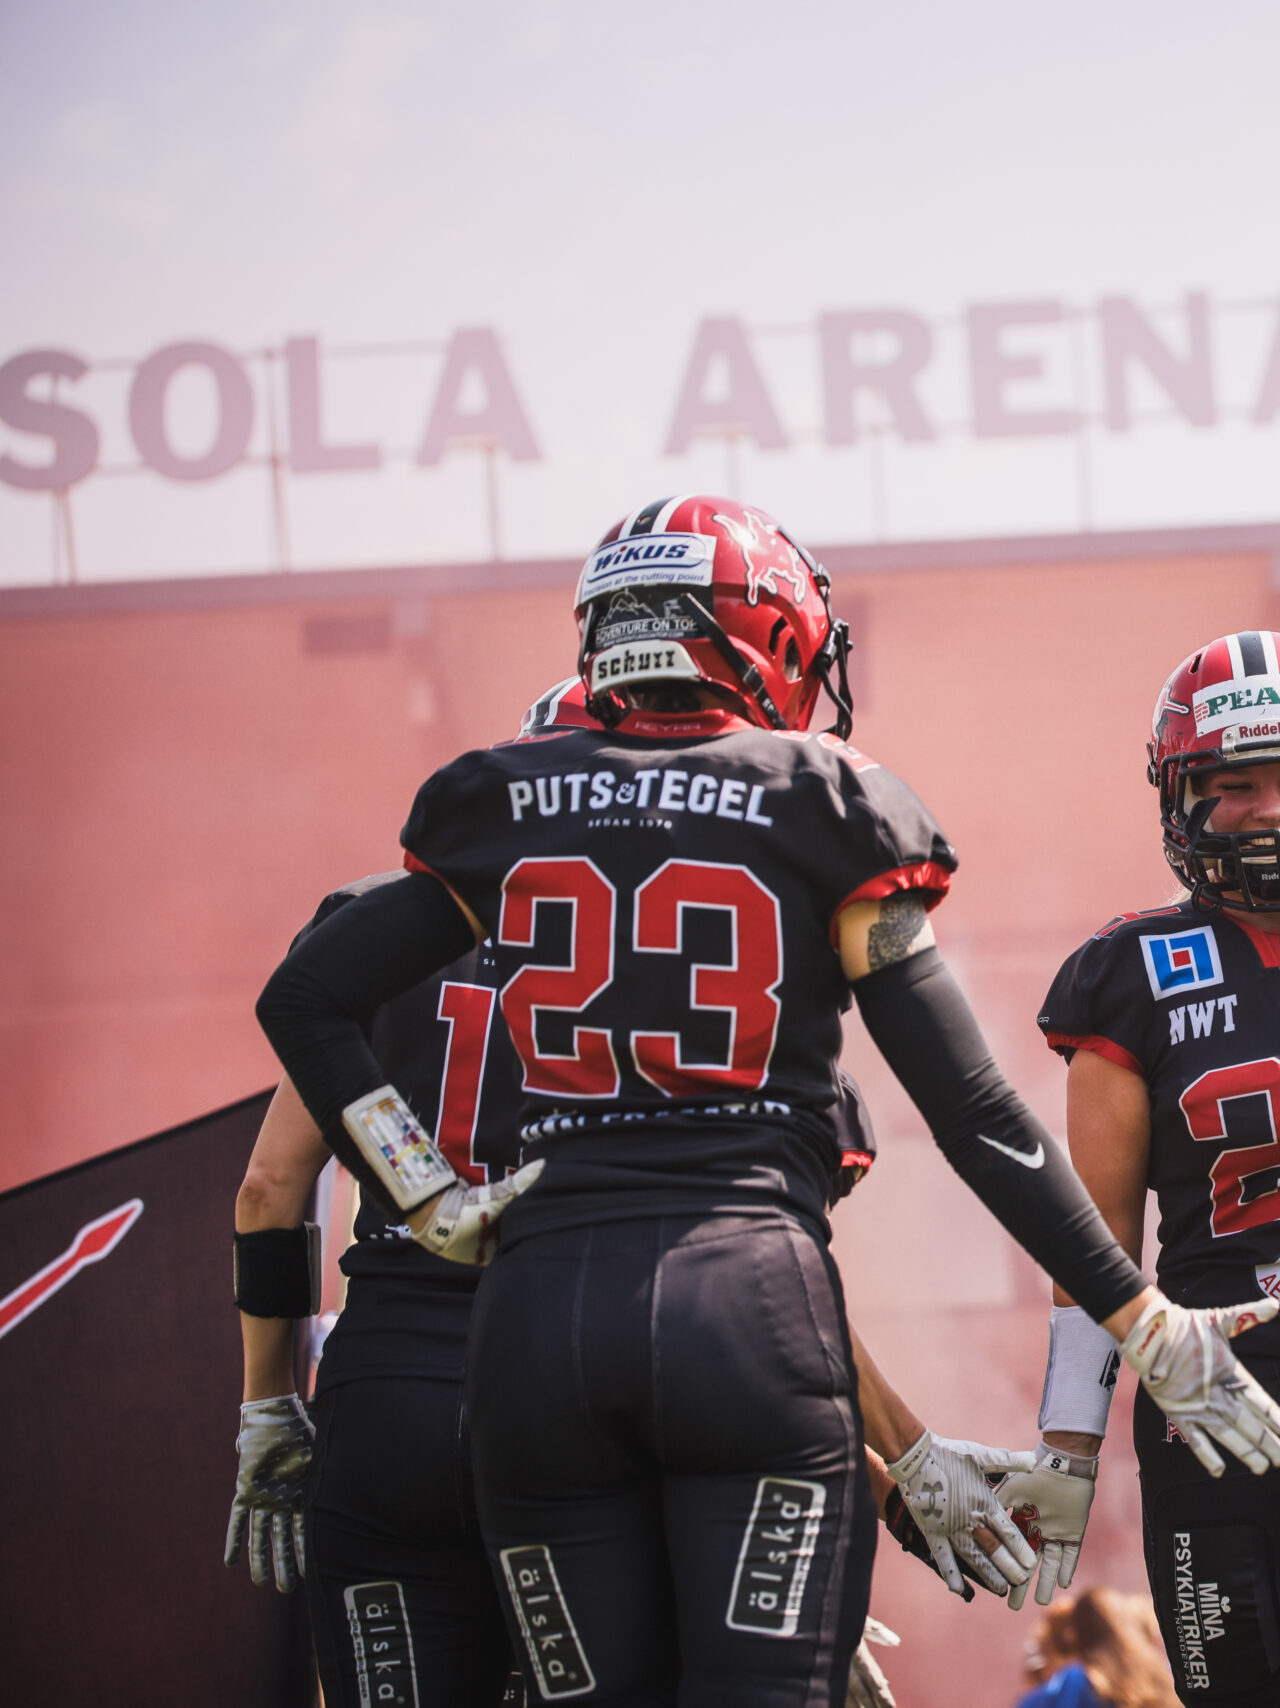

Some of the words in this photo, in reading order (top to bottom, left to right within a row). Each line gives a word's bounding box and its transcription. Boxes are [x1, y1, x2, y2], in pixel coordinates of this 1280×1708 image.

[0, 325, 544, 490] SOLA
[499, 856, 783, 1099] 23
[1169, 994, 1238, 1045] NWT
[749, 1502, 801, 1611] älska
[1174, 1532, 1210, 1689] PSYKIATRIKER
[366, 1603, 402, 1700] älska
[519, 1568, 565, 1678] älska
[1174, 1617, 1189, 1669] NORDEN
[1184, 1673, 1193, 1689] AB
[1198, 1582, 1226, 1641] MINA
